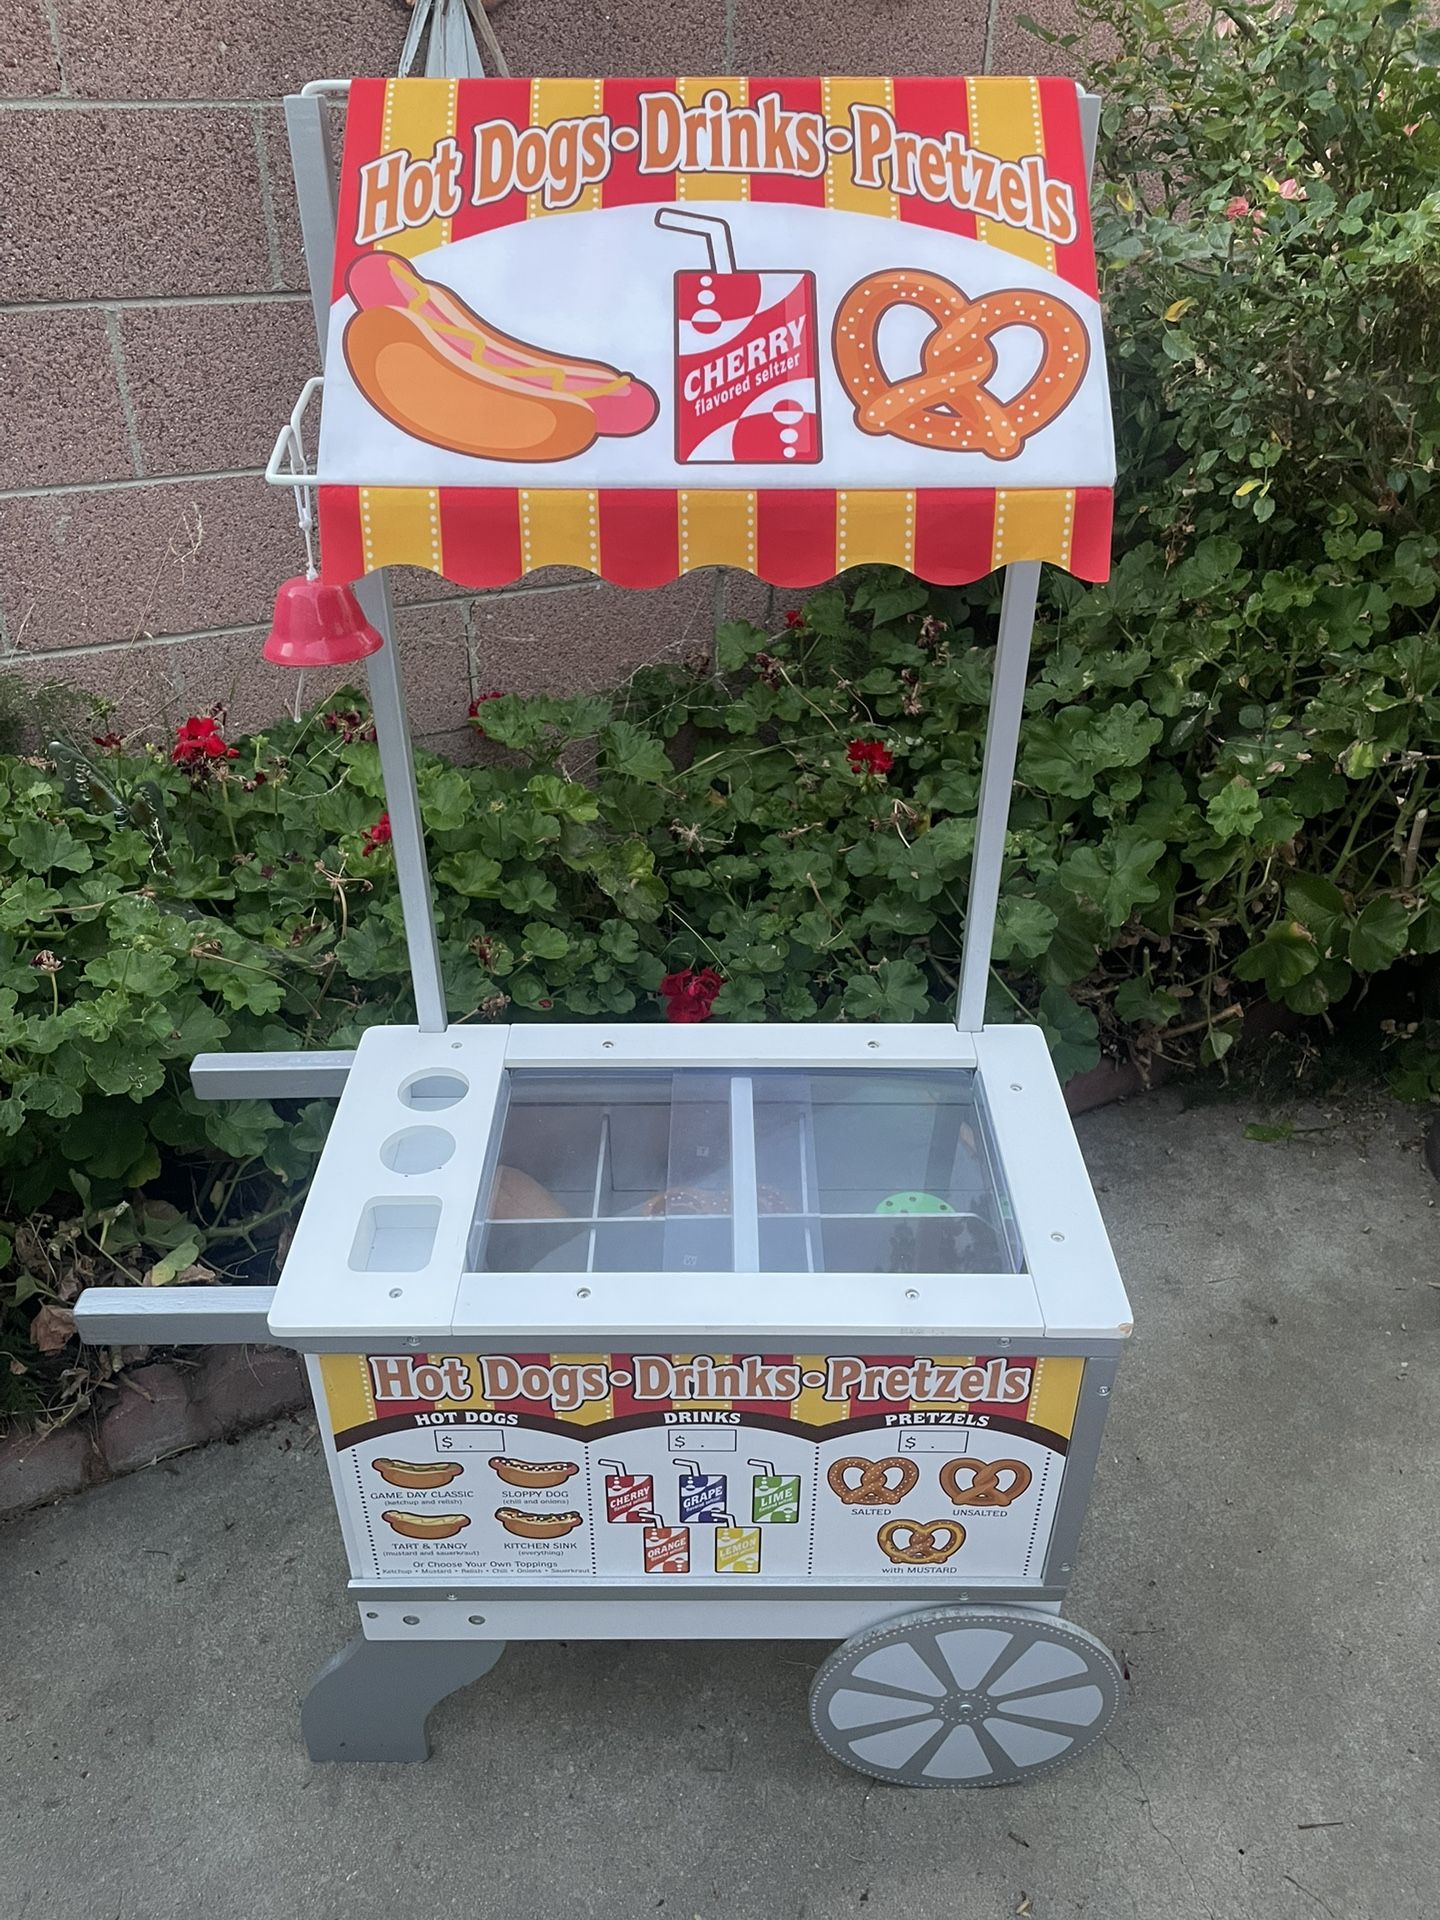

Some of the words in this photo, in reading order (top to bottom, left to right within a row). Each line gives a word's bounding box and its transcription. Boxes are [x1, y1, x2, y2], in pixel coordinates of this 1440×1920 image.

[353, 134, 462, 247] Hot
[472, 113, 610, 210] Dogs
[638, 88, 826, 178] Drinks
[849, 102, 1079, 246] Pretzels
[683, 313, 808, 402] CHERRY
[693, 377, 753, 418] flavored
[754, 352, 802, 389] seltzer
[367, 1353, 472, 1401] Hot
[478, 1353, 610, 1412] Dogs
[632, 1353, 802, 1401] Drinks
[824, 1355, 1032, 1403] Pretzels
[414, 1411, 458, 1426] HOT
[464, 1411, 519, 1426] DOGS
[663, 1411, 741, 1425] DRINKS
[885, 1411, 990, 1428] PRETZELS
[441, 1435, 453, 1449] $
[674, 1435, 686, 1449] $
[904, 1435, 916, 1449] $
[370, 1491, 403, 1500] GAME
[406, 1491, 428, 1499] DAY
[431, 1490, 475, 1499] CLASSIC
[501, 1490, 542, 1499] SLOPPY
[545, 1490, 569, 1499] DOG
[609, 1486, 650, 1509] CHERRY
[683, 1486, 723, 1509] GRAPE
[760, 1487, 793, 1508] LIME
[384, 1499, 420, 1507] (ketchup
[851, 1508, 891, 1516] SALTED
[952, 1509, 1008, 1518] UNSALTED
[391, 1542, 420, 1550] TART
[422, 1542, 431, 1550] &
[434, 1542, 469, 1550] TANGY
[503, 1542, 551, 1550] KITCHEN
[552, 1542, 578, 1550] SINK
[647, 1537, 687, 1559] ORANGE
[719, 1537, 758, 1558] LEMON
[518, 1550, 564, 1558] (everything)
[413, 1560, 425, 1568] Or
[427, 1560, 463, 1568] Choose
[466, 1560, 487, 1568] Your
[490, 1560, 512, 1568] Own
[515, 1560, 558, 1569] Toppings
[881, 1566, 904, 1574] with
[907, 1566, 958, 1574] MUSTARD
